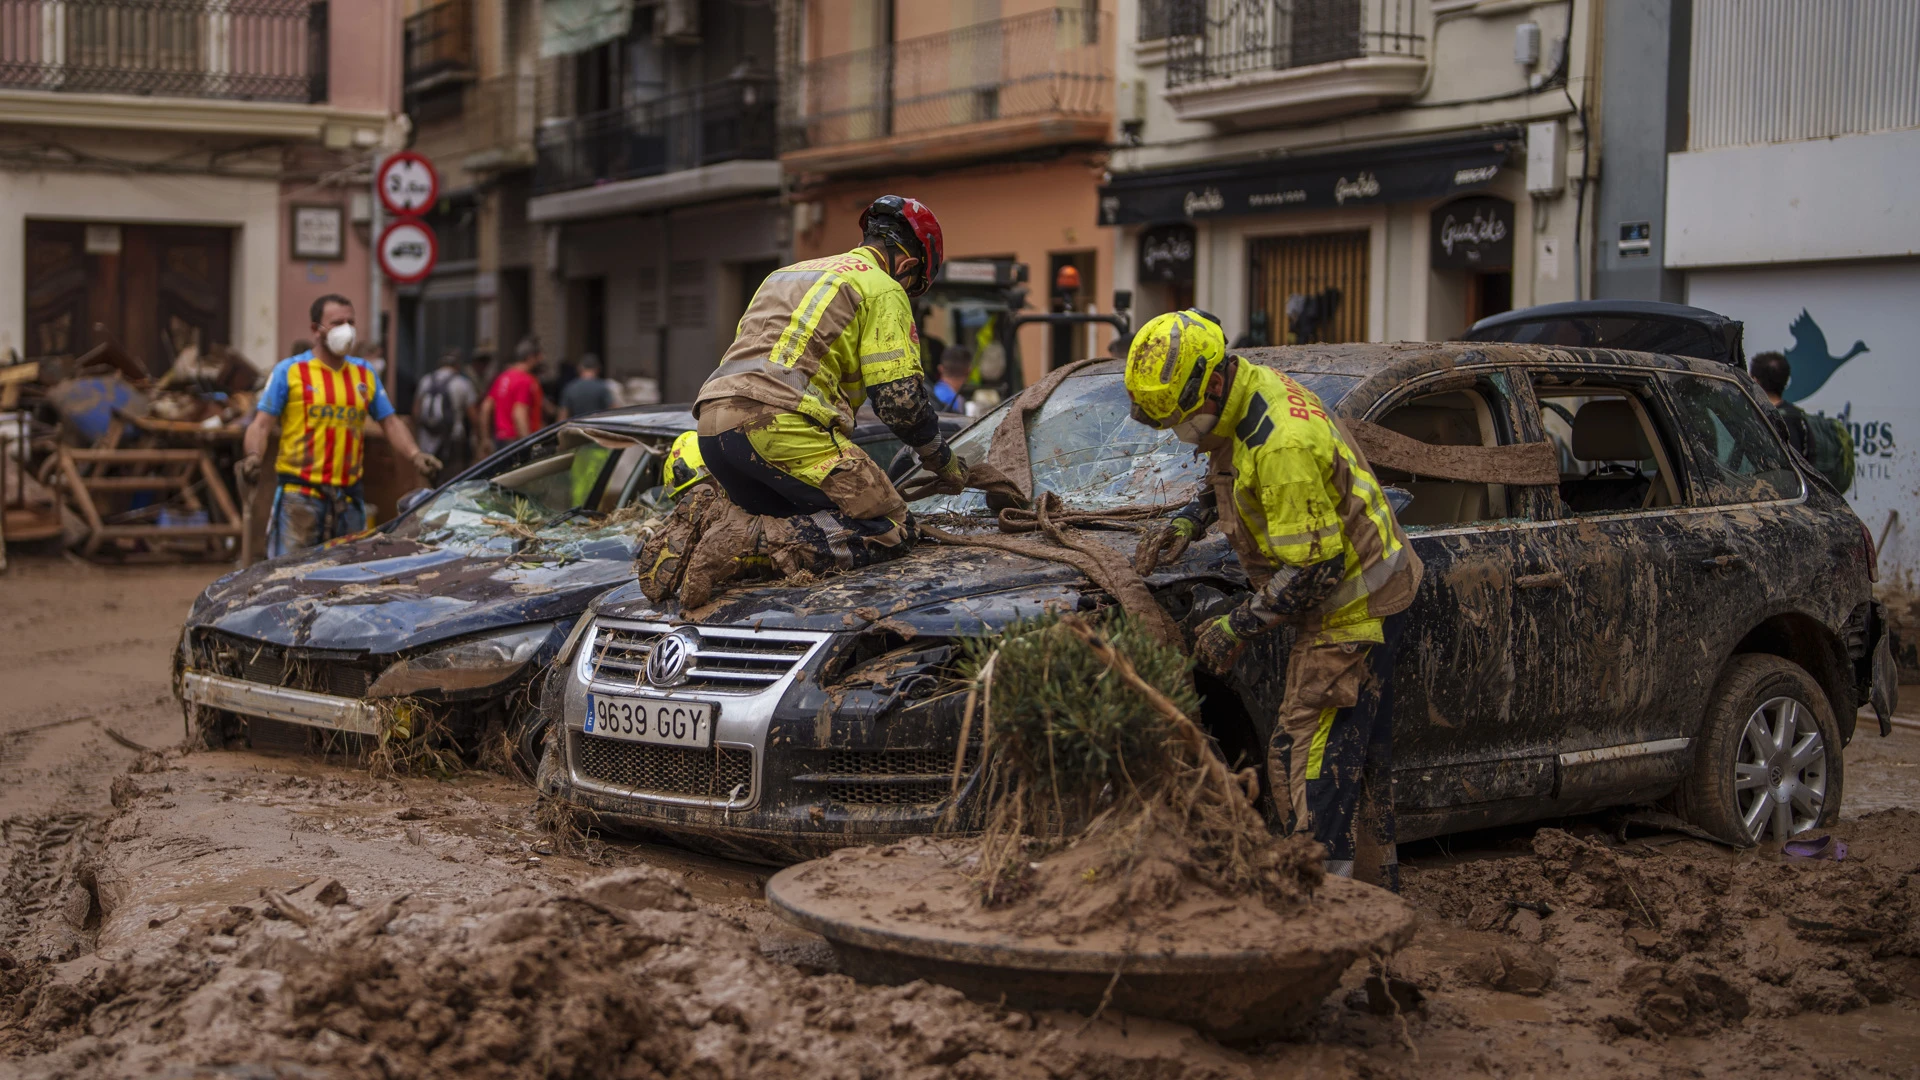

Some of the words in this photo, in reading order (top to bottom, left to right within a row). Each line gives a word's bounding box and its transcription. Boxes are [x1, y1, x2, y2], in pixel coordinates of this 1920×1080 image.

[1442, 207, 1507, 256] Guateke
[1856, 463, 1891, 479] NTIL
[598, 701, 647, 735] 9639
[657, 707, 702, 740] GGY
